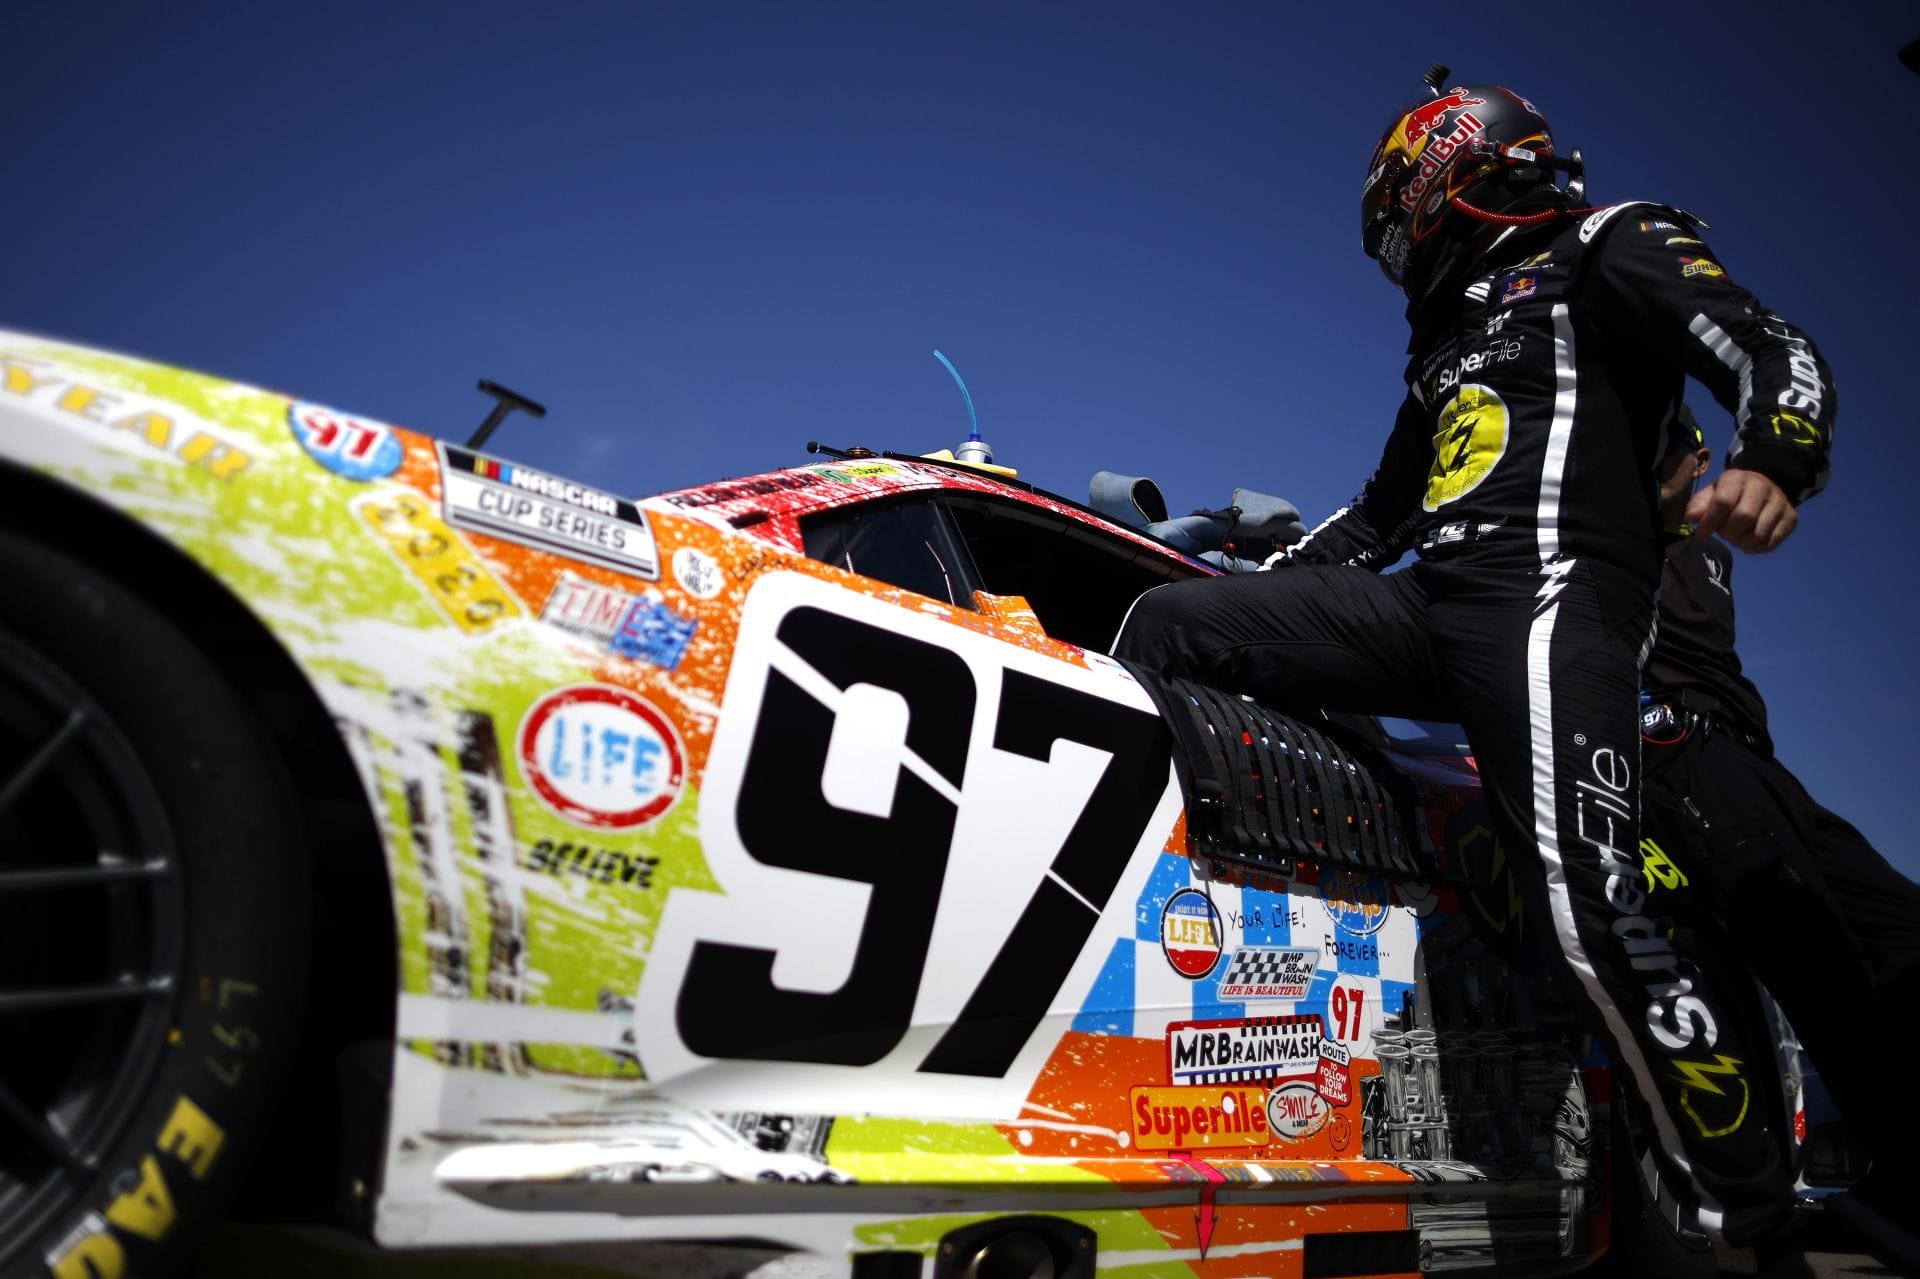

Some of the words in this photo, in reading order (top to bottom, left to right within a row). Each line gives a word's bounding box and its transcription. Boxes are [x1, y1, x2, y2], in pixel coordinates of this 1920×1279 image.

[1399, 151, 1440, 213] Red
[1429, 111, 1486, 164] Bull
[1379, 221, 1395, 258] Safety
[1386, 224, 1402, 263] Culture
[0, 352, 251, 482] YEAR
[303, 410, 385, 462] 97
[512, 468, 618, 517] NASCAR
[478, 488, 532, 516] CUP
[540, 506, 626, 550] SERIES
[561, 581, 652, 638] TIME
[677, 605, 1173, 1078] 97
[1168, 917, 1217, 946] LIFE
[1228, 910, 1262, 929] YOUR
[1222, 984, 1244, 995] LIFE
[1245, 985, 1254, 995] IS
[1255, 985, 1304, 996] BEAUTIFUL
[1282, 974, 1309, 984] WASH
[1331, 985, 1364, 1042] 97
[1322, 1044, 1347, 1063] ROUTE
[1330, 1062, 1338, 1070] TO
[1320, 1066, 1347, 1084] FOLLOW
[1325, 1076, 1343, 1092] YOUR
[1276, 1094, 1321, 1119] SMILE
[1319, 1086, 1348, 1103] DREAMS
